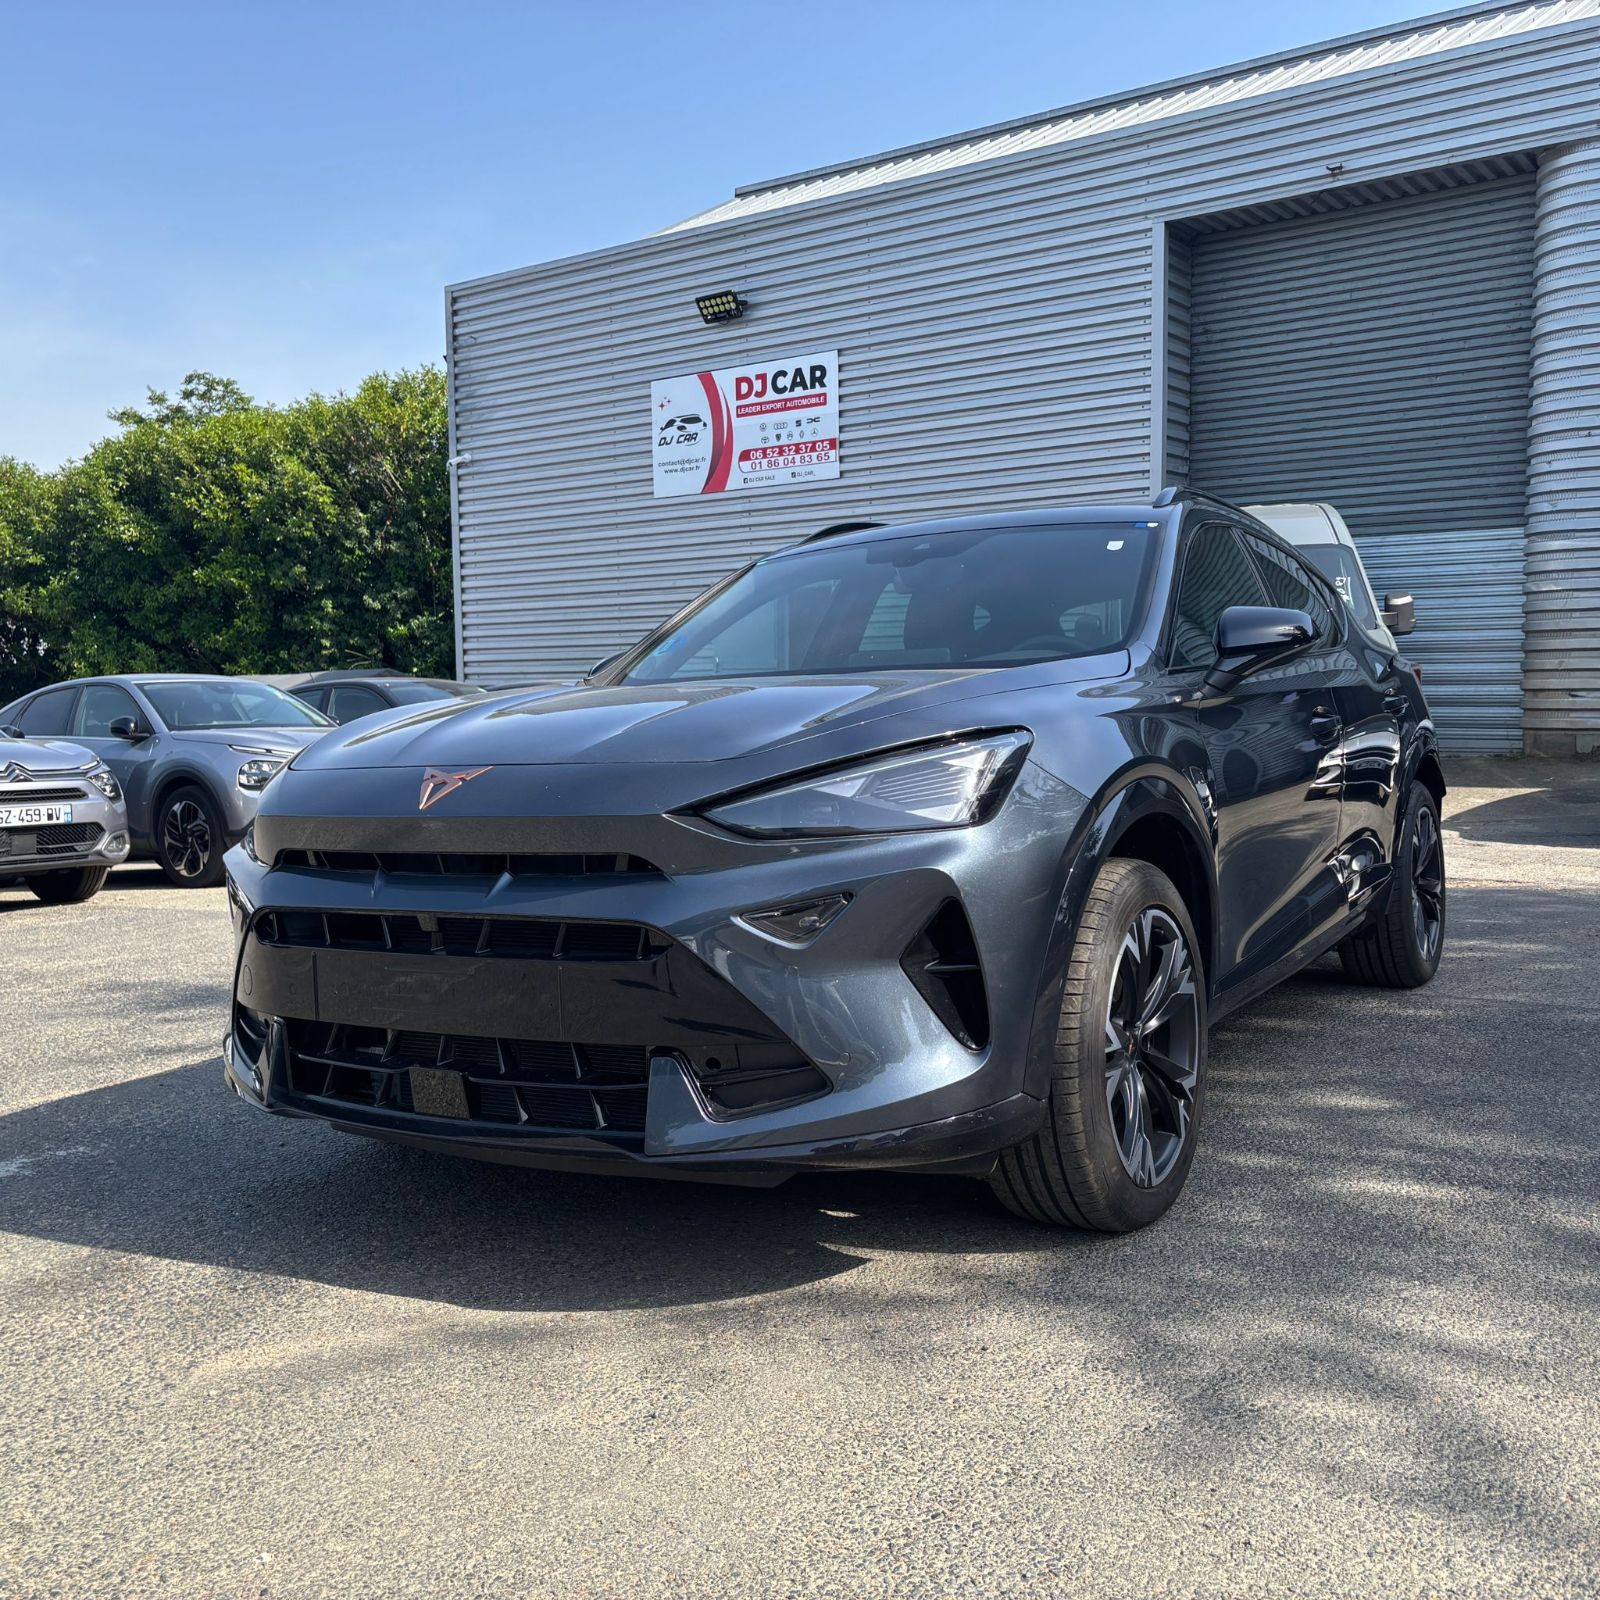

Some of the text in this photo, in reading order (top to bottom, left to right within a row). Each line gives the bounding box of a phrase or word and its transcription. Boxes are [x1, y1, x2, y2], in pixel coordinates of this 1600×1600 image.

[735, 364, 827, 401] DJ CAR
[737, 396, 825, 415] LEADER EXPORT AUTOMOBILE
[658, 432, 699, 447] DJ CAR
[750, 441, 830, 460] 06 52 32 37 05
[658, 456, 706, 467] contact@djcar.fr
[664, 465, 701, 474] www.djcar.fr
[751, 452, 830, 470] 01 86 04 83 65
